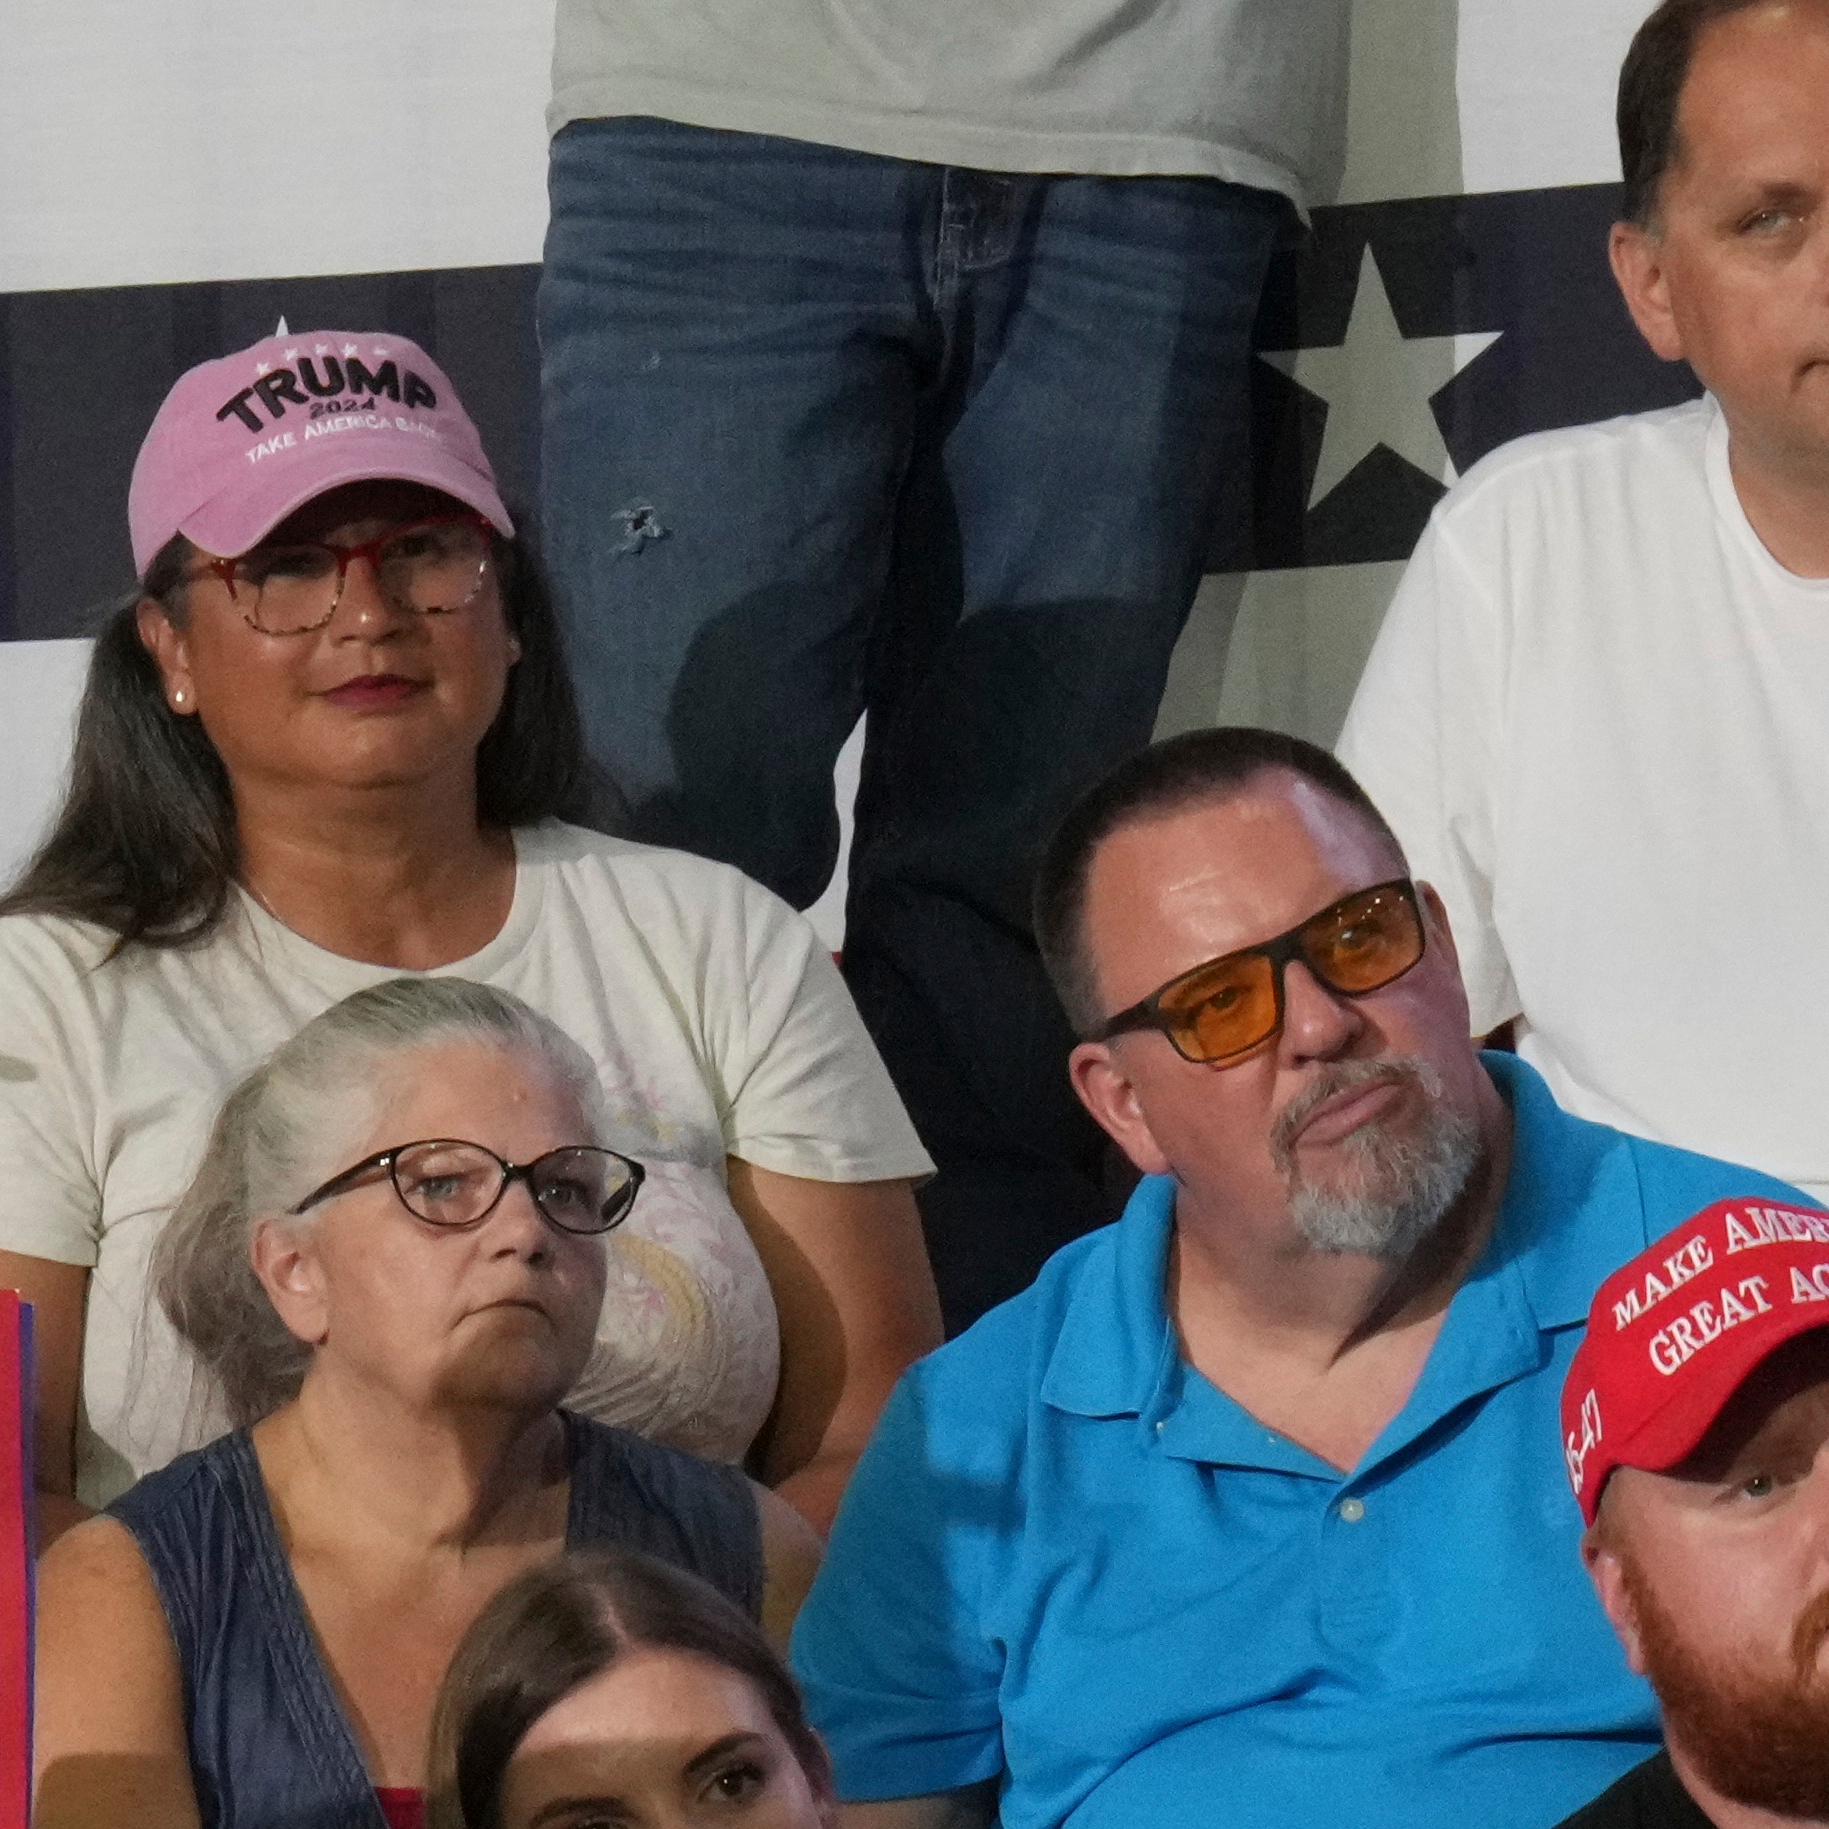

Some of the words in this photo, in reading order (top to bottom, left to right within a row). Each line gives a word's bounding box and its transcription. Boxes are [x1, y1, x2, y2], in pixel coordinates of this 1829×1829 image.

[215, 355, 437, 434] TRUMP
[308, 397, 377, 420] 2024
[245, 431, 298, 464] TAKE
[304, 412, 391, 441] AMERICA
[1611, 1234, 1715, 1332] MAKE
[1648, 1274, 1773, 1376] GREAT
